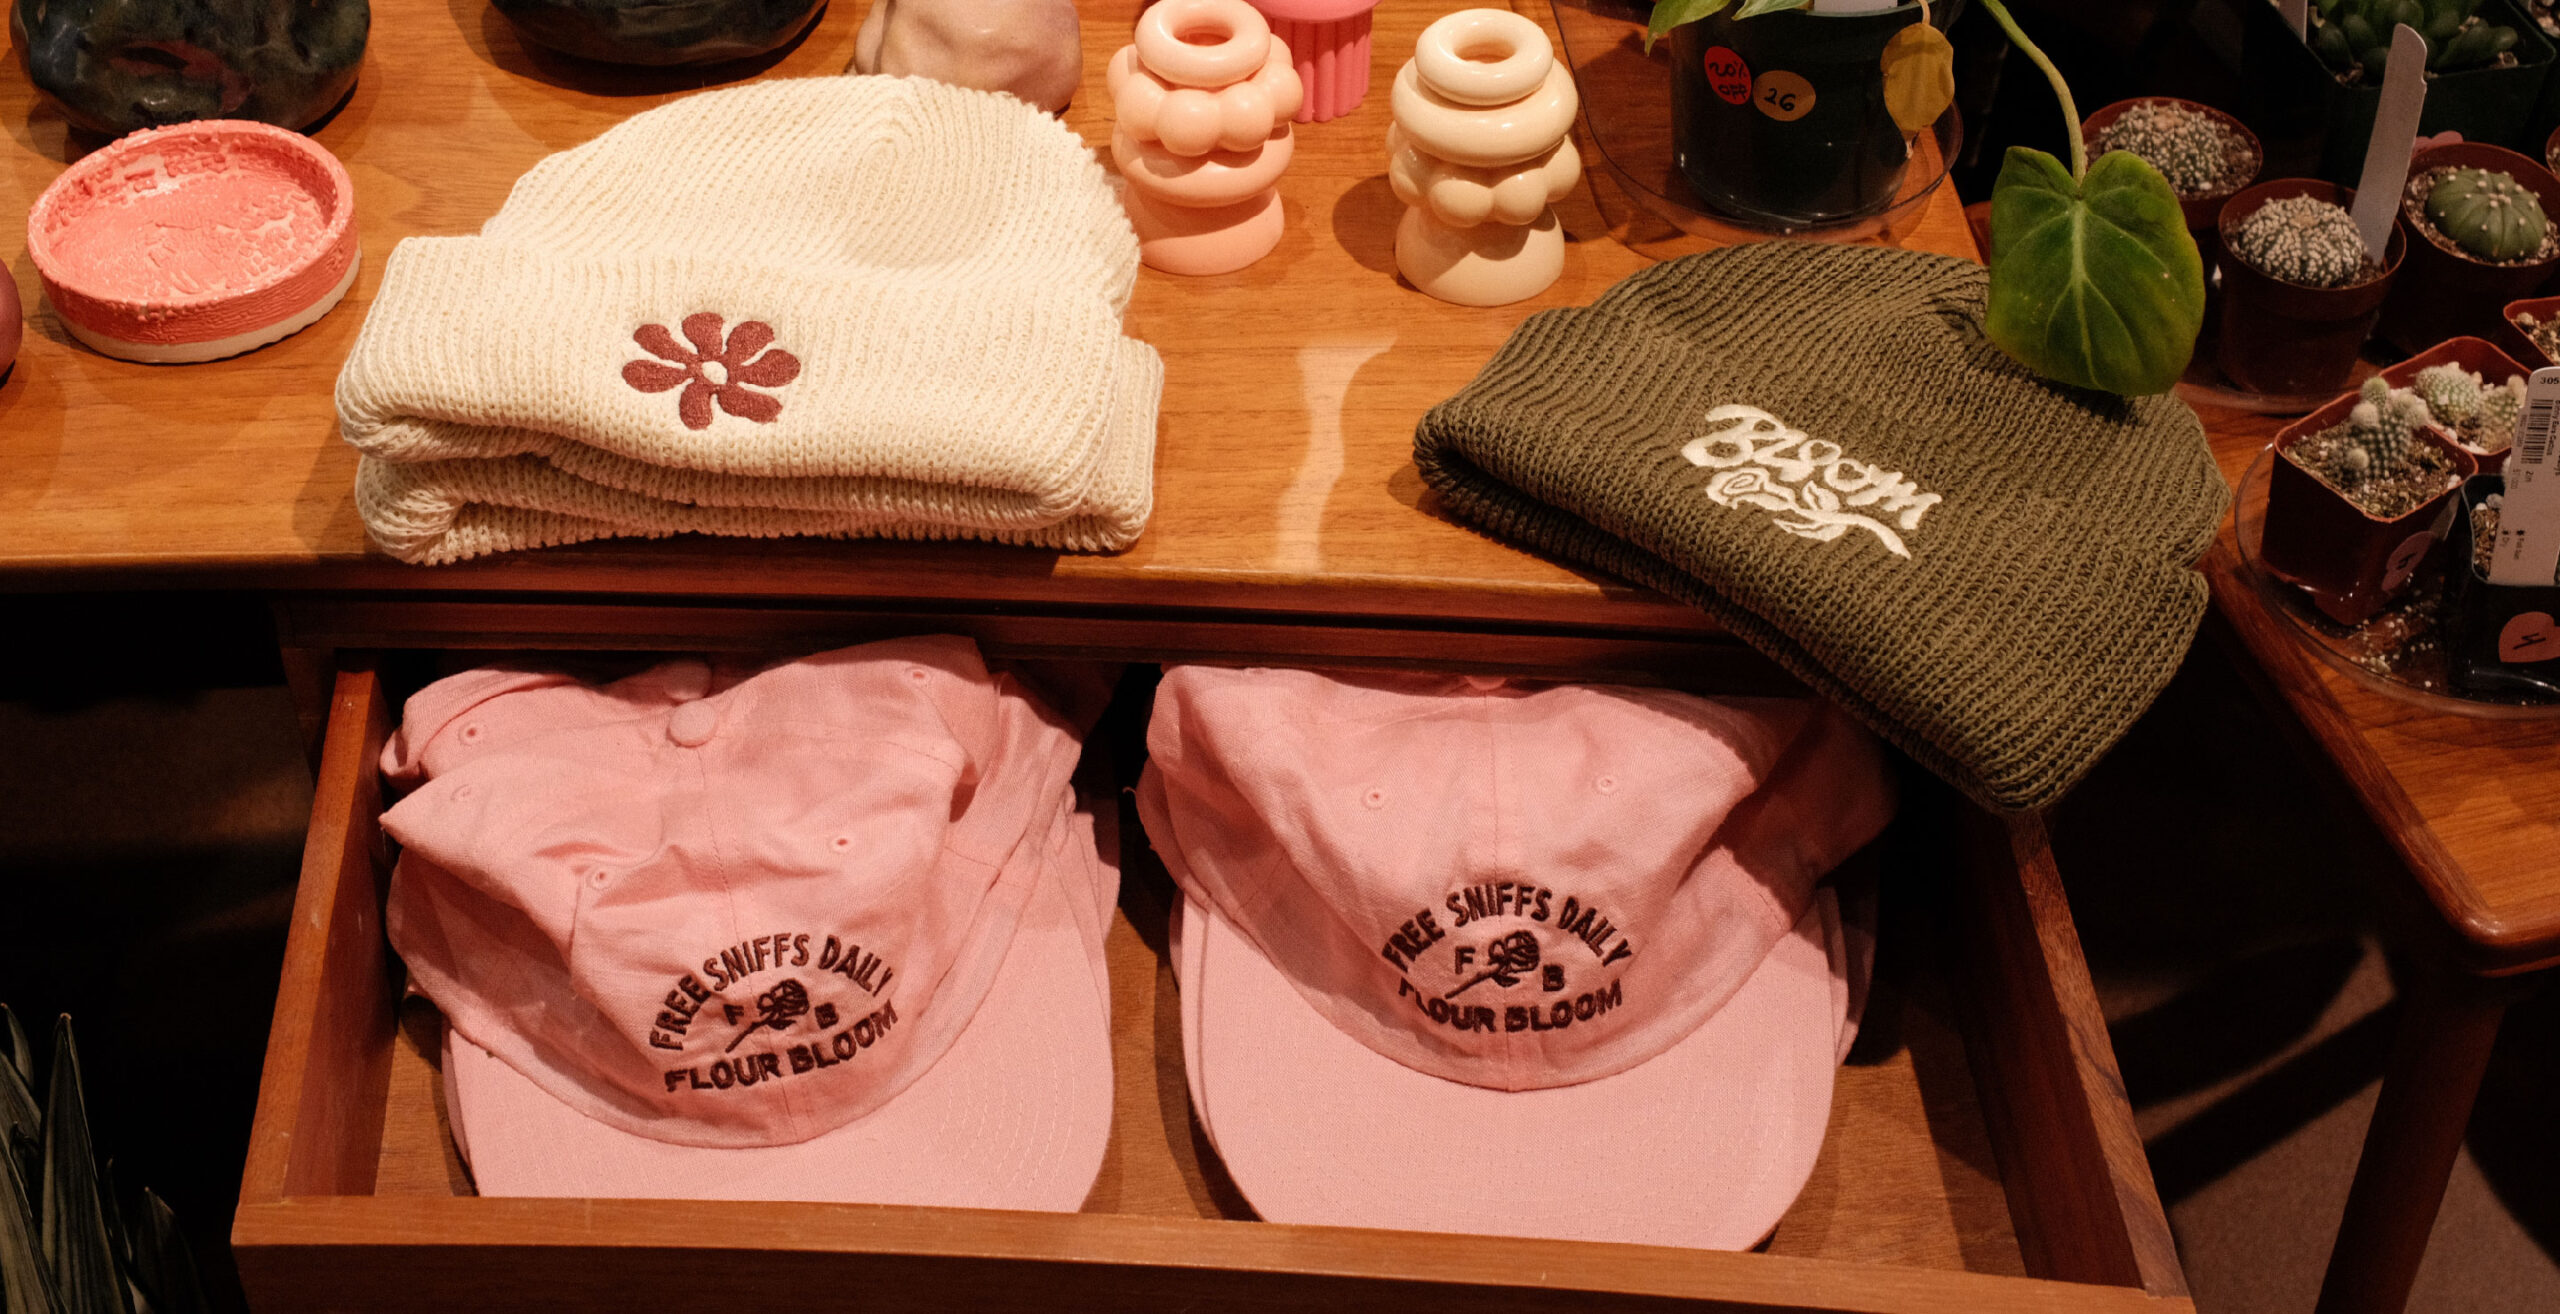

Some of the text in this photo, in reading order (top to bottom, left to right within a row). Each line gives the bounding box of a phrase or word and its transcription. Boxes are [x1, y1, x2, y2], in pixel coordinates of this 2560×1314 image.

[1709, 61, 1748, 80] 20%
[1718, 83, 1748, 100] OFF
[1764, 87, 1797, 112] 26
[1382, 882, 1632, 973] FREE SNIFFS DAILY
[649, 932, 894, 1051] FREE SNIFFS DAILY
[1455, 946, 1565, 992] F B
[723, 1002, 839, 1030] F B
[1398, 976, 1622, 1033] FLOUR BLOOM
[664, 999, 898, 1092] FLOUR BLOOM
